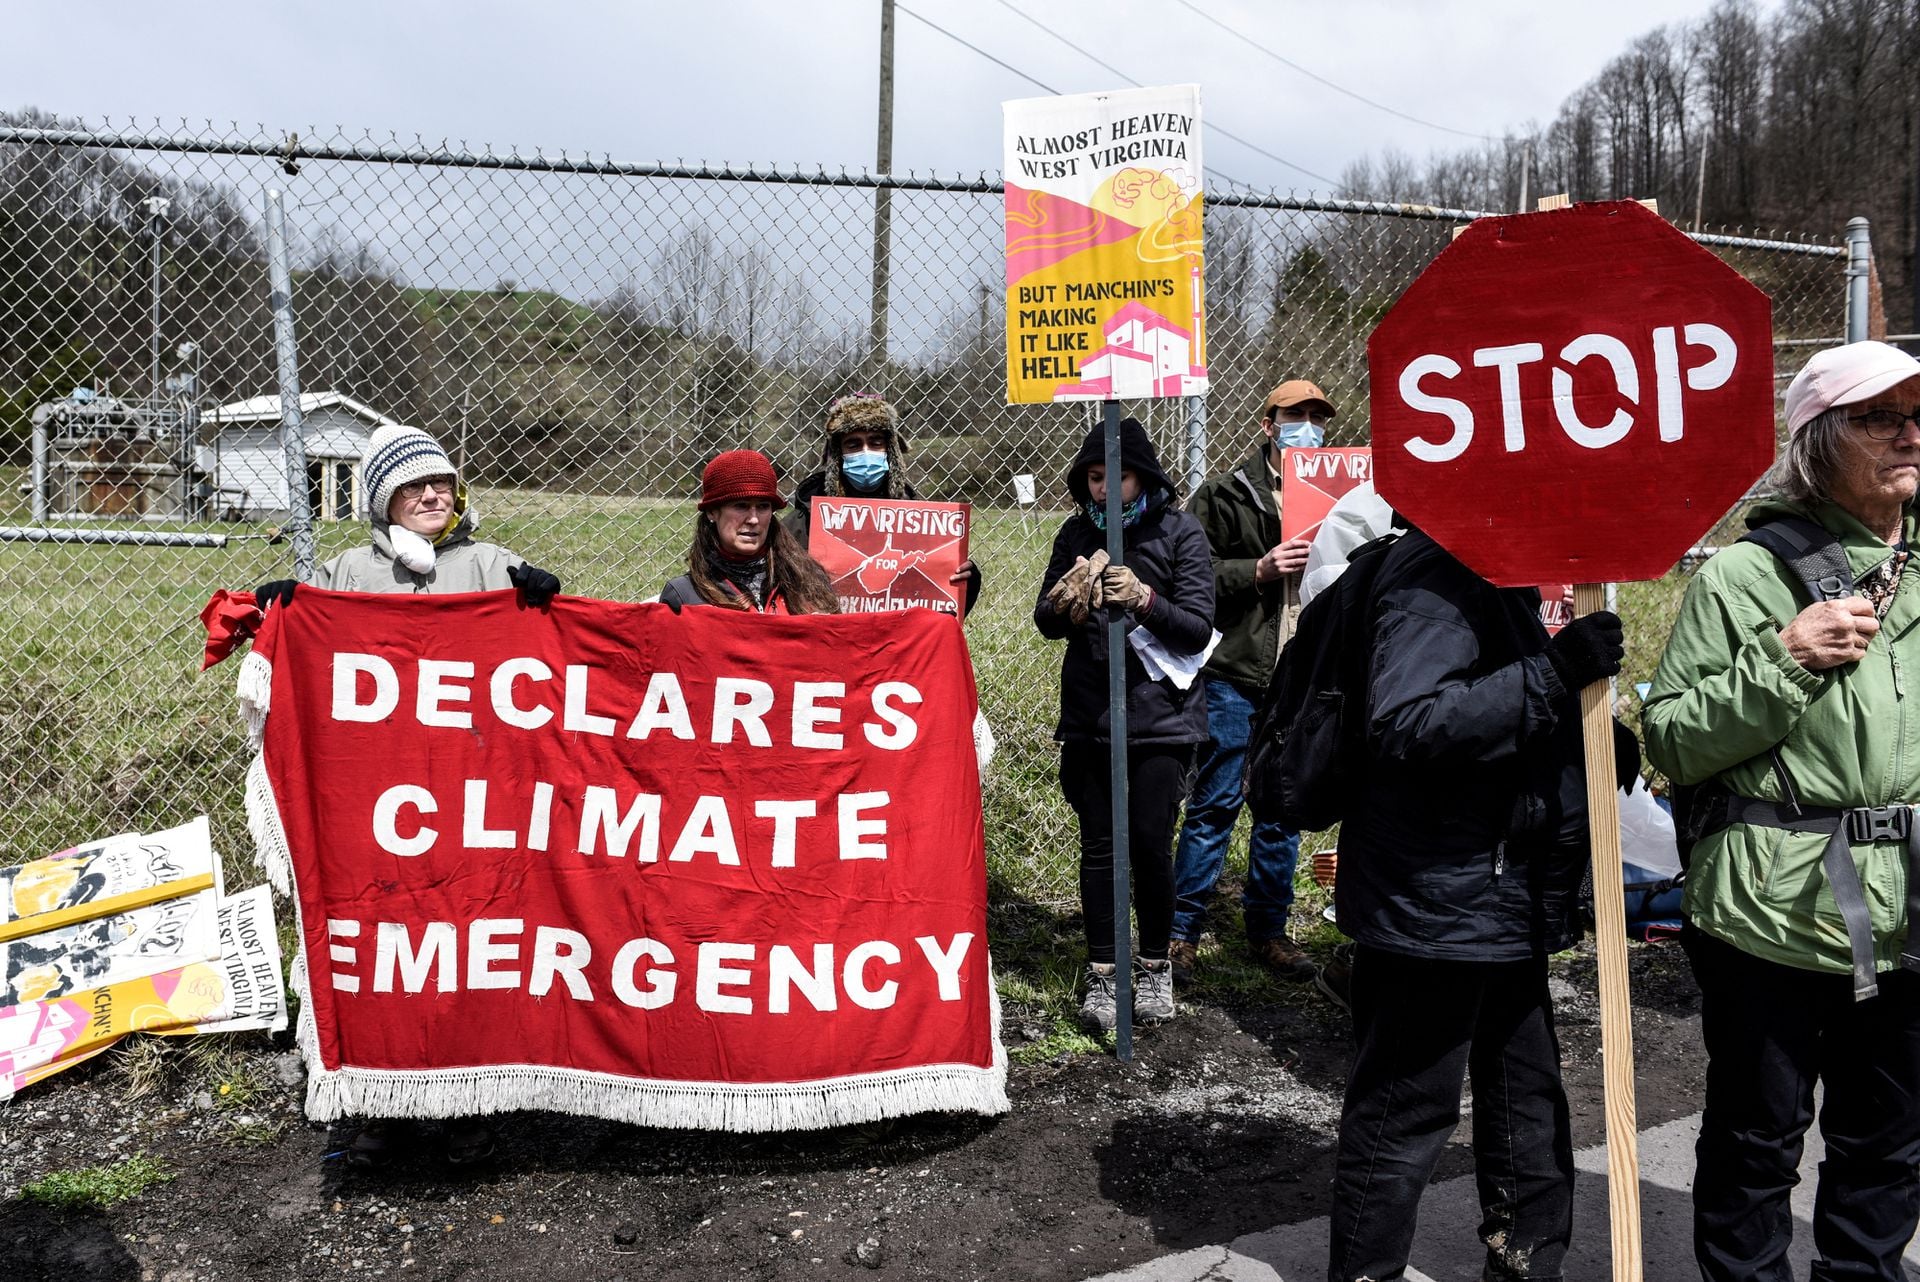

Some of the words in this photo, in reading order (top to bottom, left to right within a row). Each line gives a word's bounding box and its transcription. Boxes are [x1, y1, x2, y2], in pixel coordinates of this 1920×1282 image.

[1016, 126, 1102, 155] ALMOST
[1111, 112, 1193, 141] HEAVEN
[1019, 158, 1080, 180] WEST
[1089, 138, 1188, 171] VIRGINIA
[1019, 285, 1057, 304] BUT
[1065, 278, 1175, 303] MANCHIN'S
[1019, 307, 1097, 329] MAKING
[1020, 334, 1039, 353] IT
[1046, 332, 1089, 352] LIKE
[1022, 356, 1082, 380] HELL
[1399, 323, 1738, 463] STOP
[1294, 454, 1341, 479] WV
[820, 504, 870, 531] WV
[878, 508, 964, 537] RISING
[875, 558, 899, 571] FOR
[840, 595, 887, 614] RKING
[330, 651, 923, 751] DECLARES
[372, 778, 891, 868] CLIMATE
[217, 903, 236, 947] WEST
[236, 898, 266, 956] ALMOST
[251, 962, 279, 1022] HEAVEN
[328, 917, 974, 1015] EMERGENCY
[223, 951, 254, 1021] VIRGINIA
